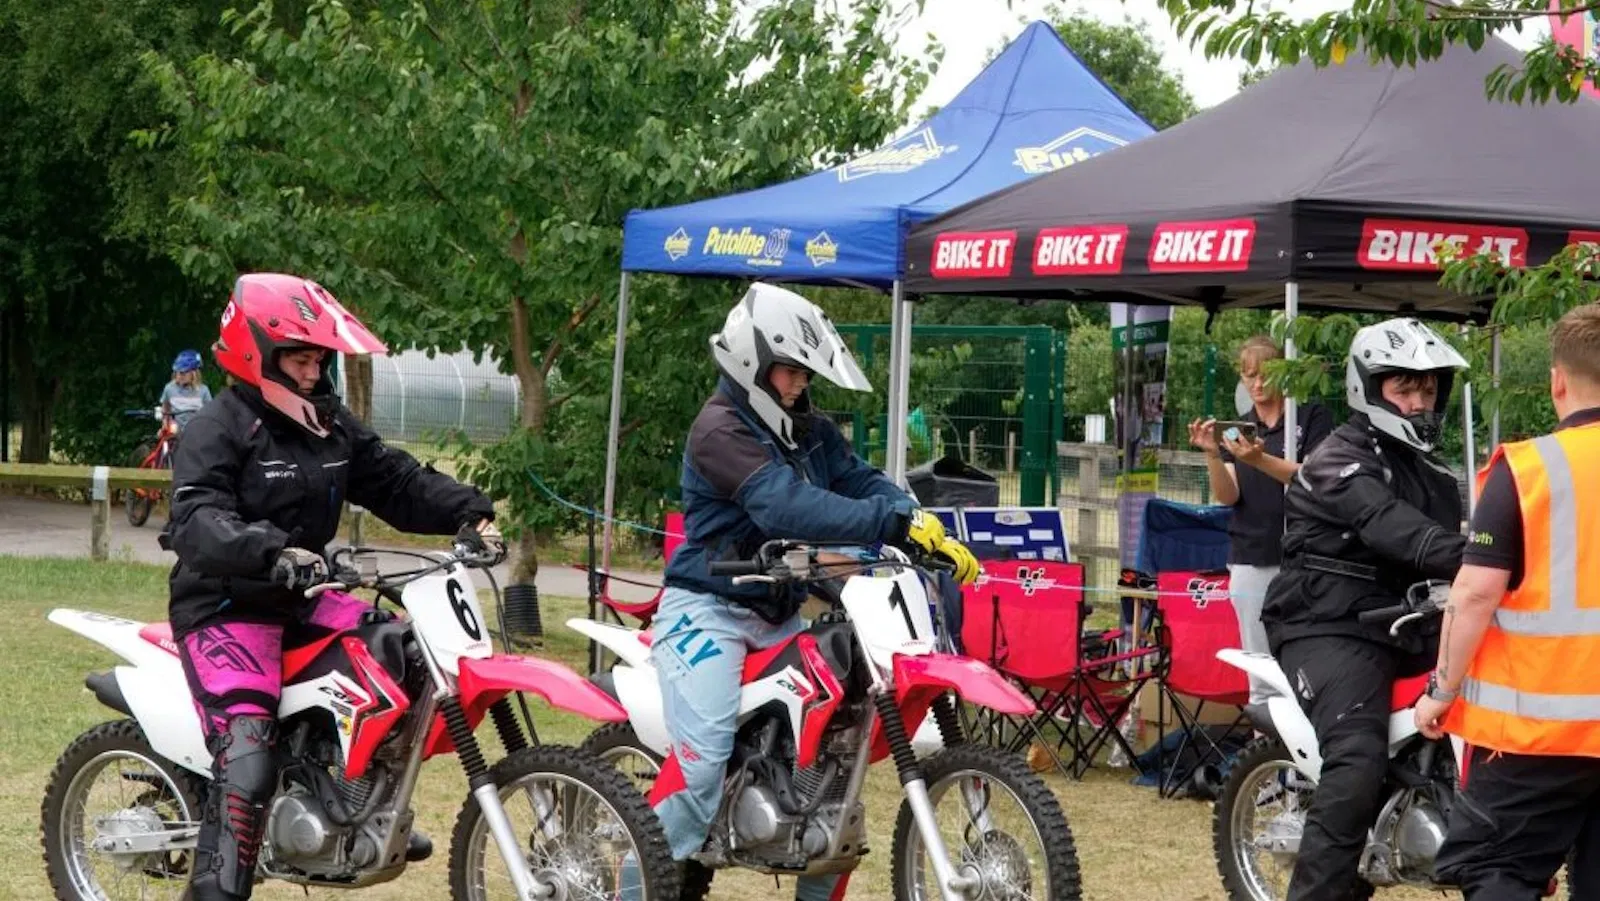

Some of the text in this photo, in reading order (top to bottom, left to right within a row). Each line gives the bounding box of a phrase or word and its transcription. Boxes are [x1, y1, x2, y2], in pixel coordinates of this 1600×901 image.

[703, 226, 767, 258] Putoline
[935, 238, 1011, 270] BIKE IT
[1036, 233, 1121, 267] BIKE IT
[1152, 228, 1249, 264] BIKE IT
[446, 577, 482, 641] 6
[887, 580, 919, 640] 1
[667, 612, 724, 668] FLY
